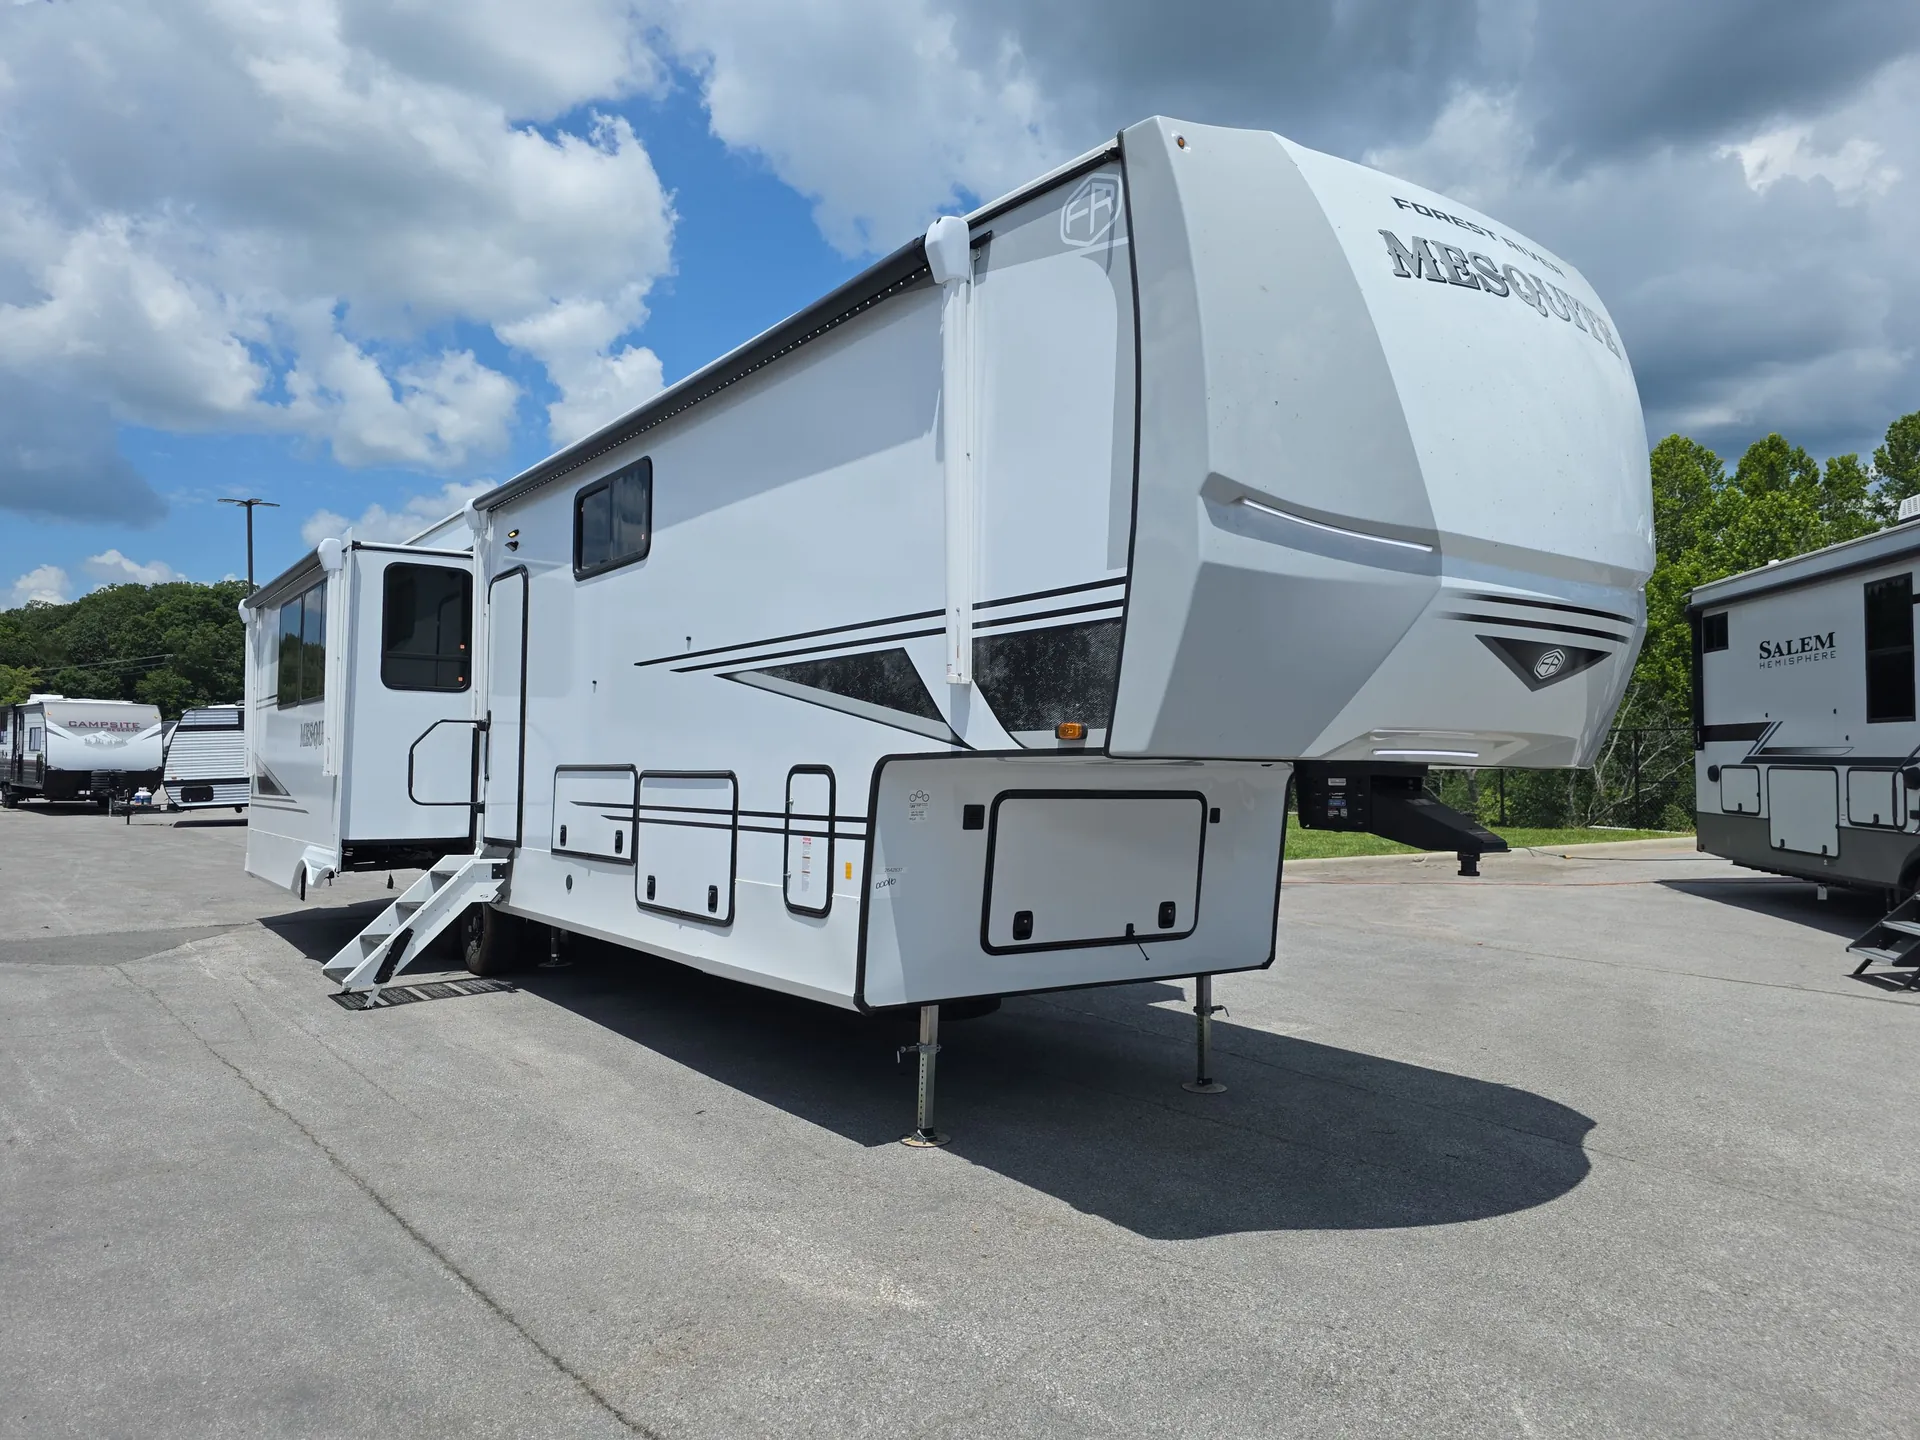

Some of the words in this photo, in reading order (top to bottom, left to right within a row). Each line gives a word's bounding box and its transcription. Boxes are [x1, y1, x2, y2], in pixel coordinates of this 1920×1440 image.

[1391, 196, 1497, 241] FOREST
[1500, 236, 1567, 279] RIVER
[1378, 229, 1622, 360] MESQUITE
[1759, 632, 1836, 660] SALEM
[1759, 650, 1837, 669] HEMISPHERE
[68, 720, 141, 729] CAMPSITE
[300, 720, 324, 750] MESQU
